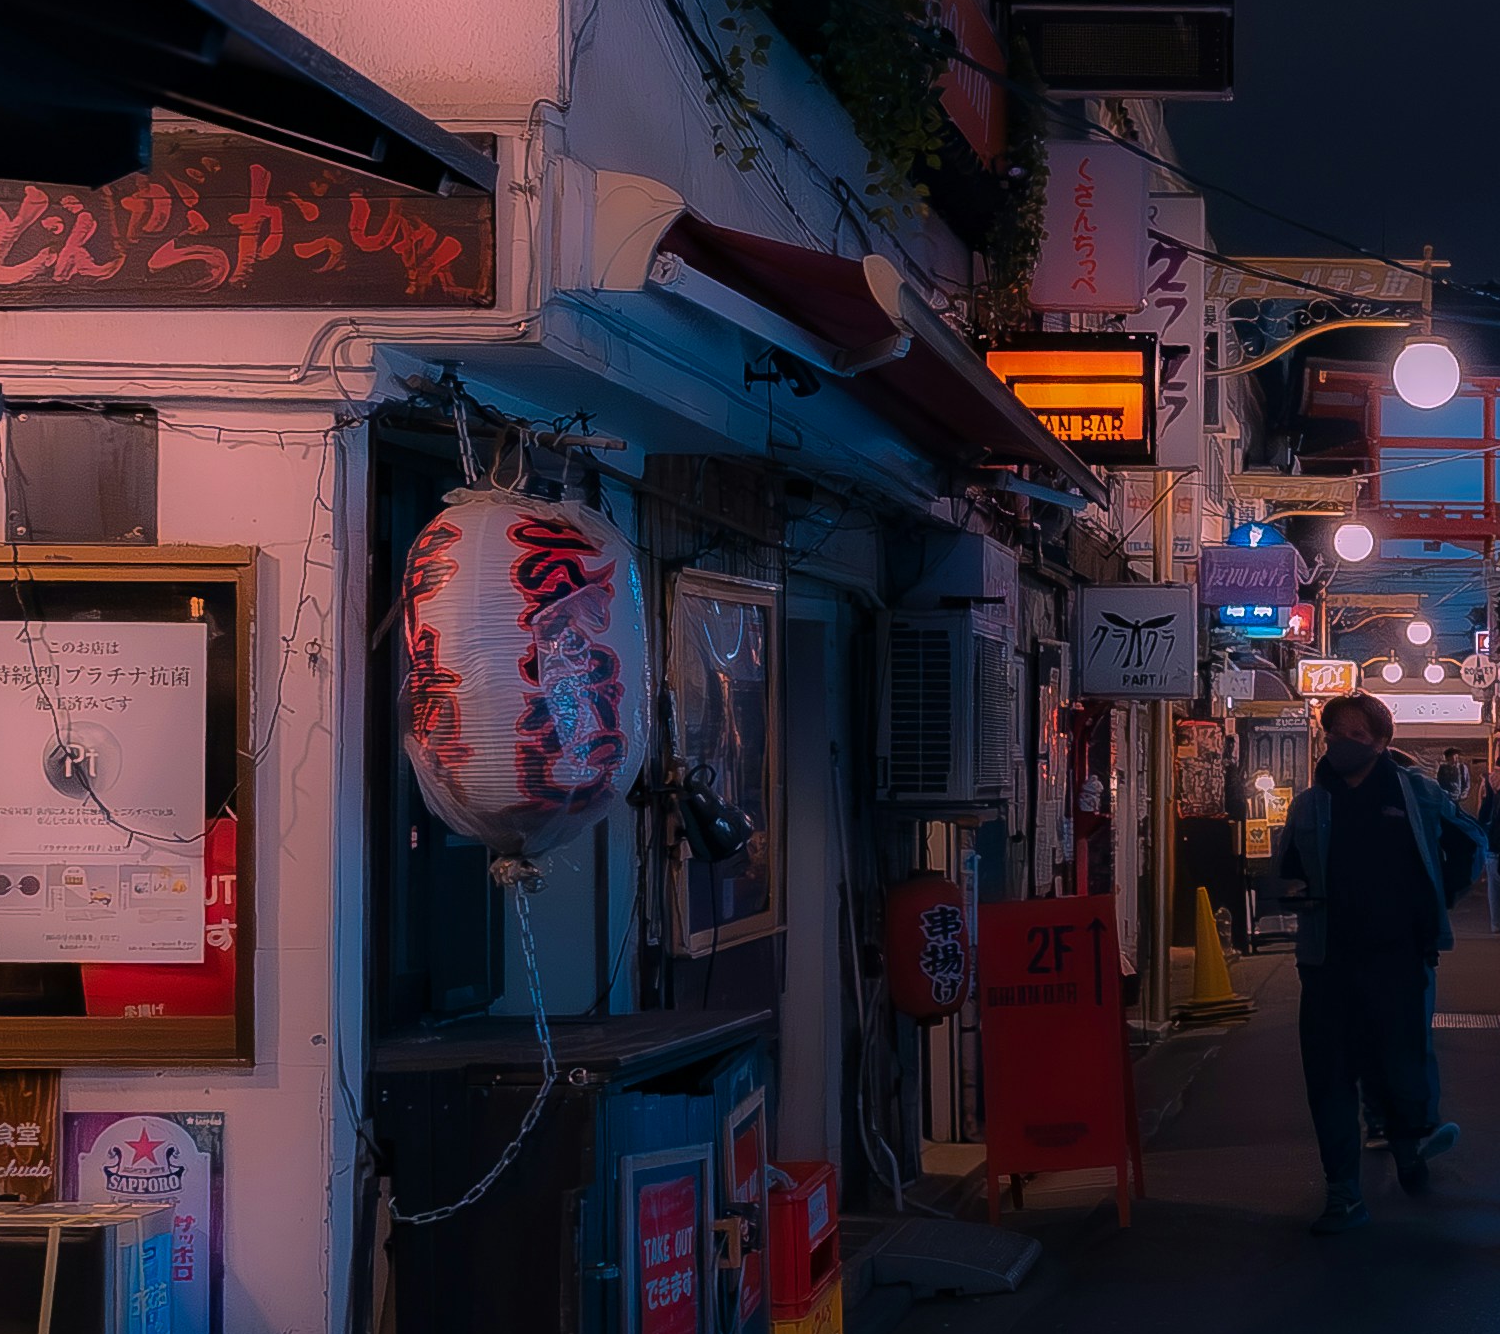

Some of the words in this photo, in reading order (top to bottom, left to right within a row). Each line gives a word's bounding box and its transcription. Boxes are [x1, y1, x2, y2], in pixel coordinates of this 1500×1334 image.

[1081, 414, 1124, 441] BAR
[49, 640, 120, 655] このお店は
[1121, 673, 1156, 687] PART
[64, 743, 99, 778] Pt
[920, 904, 966, 1006] 串揚げ
[1027, 925, 1076, 975] 2F
[108, 1172, 181, 1194] SAPPORO
[643, 1232, 670, 1269] TAKE
[673, 1226, 693, 1259] OUT
[645, 1266, 693, 1312] できます
